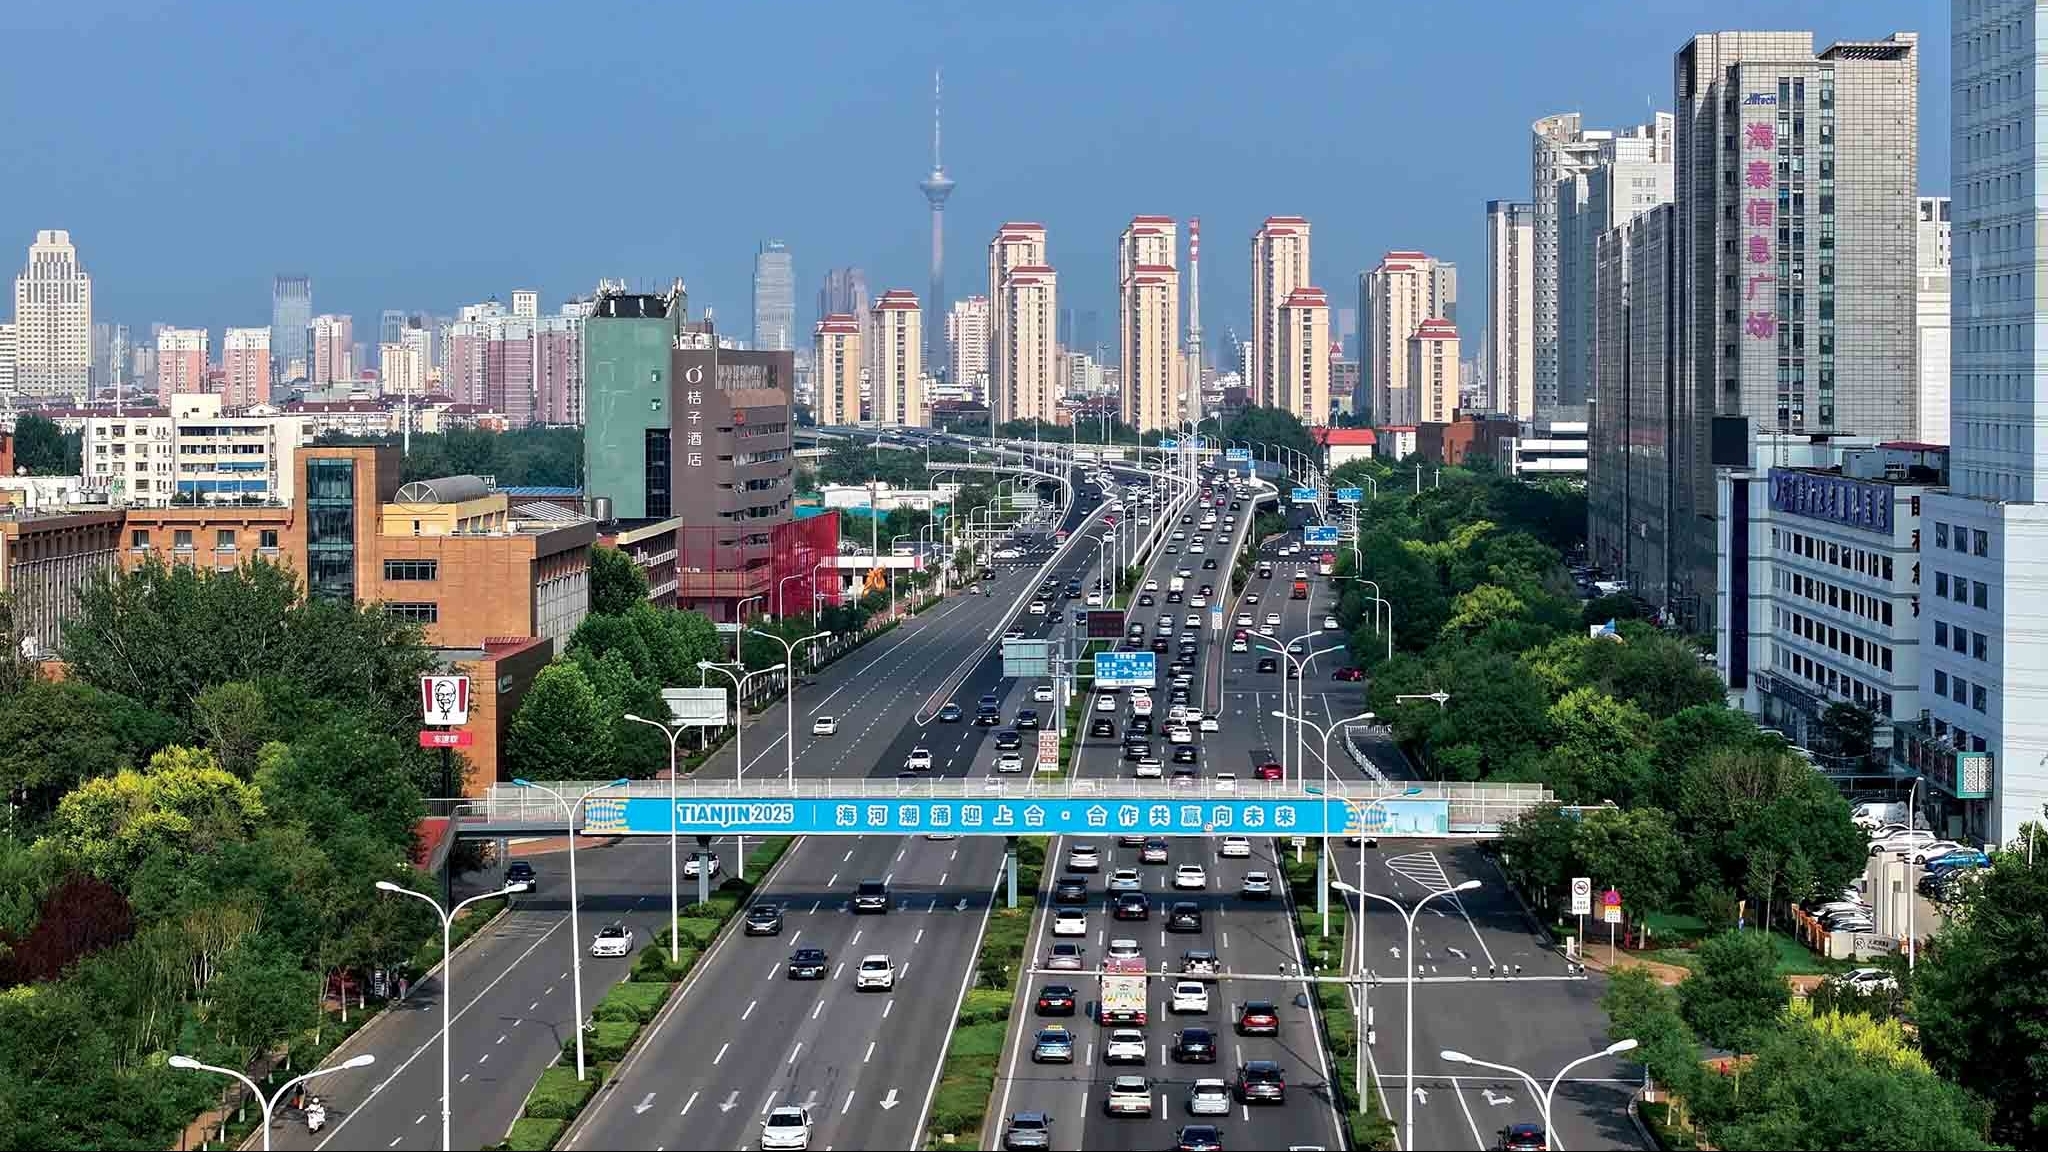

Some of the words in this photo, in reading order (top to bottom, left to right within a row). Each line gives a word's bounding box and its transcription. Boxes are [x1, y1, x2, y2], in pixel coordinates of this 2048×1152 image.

[1746, 122, 1774, 339] 海泰信息广场
[688, 390, 702, 466] 桔子酒店
